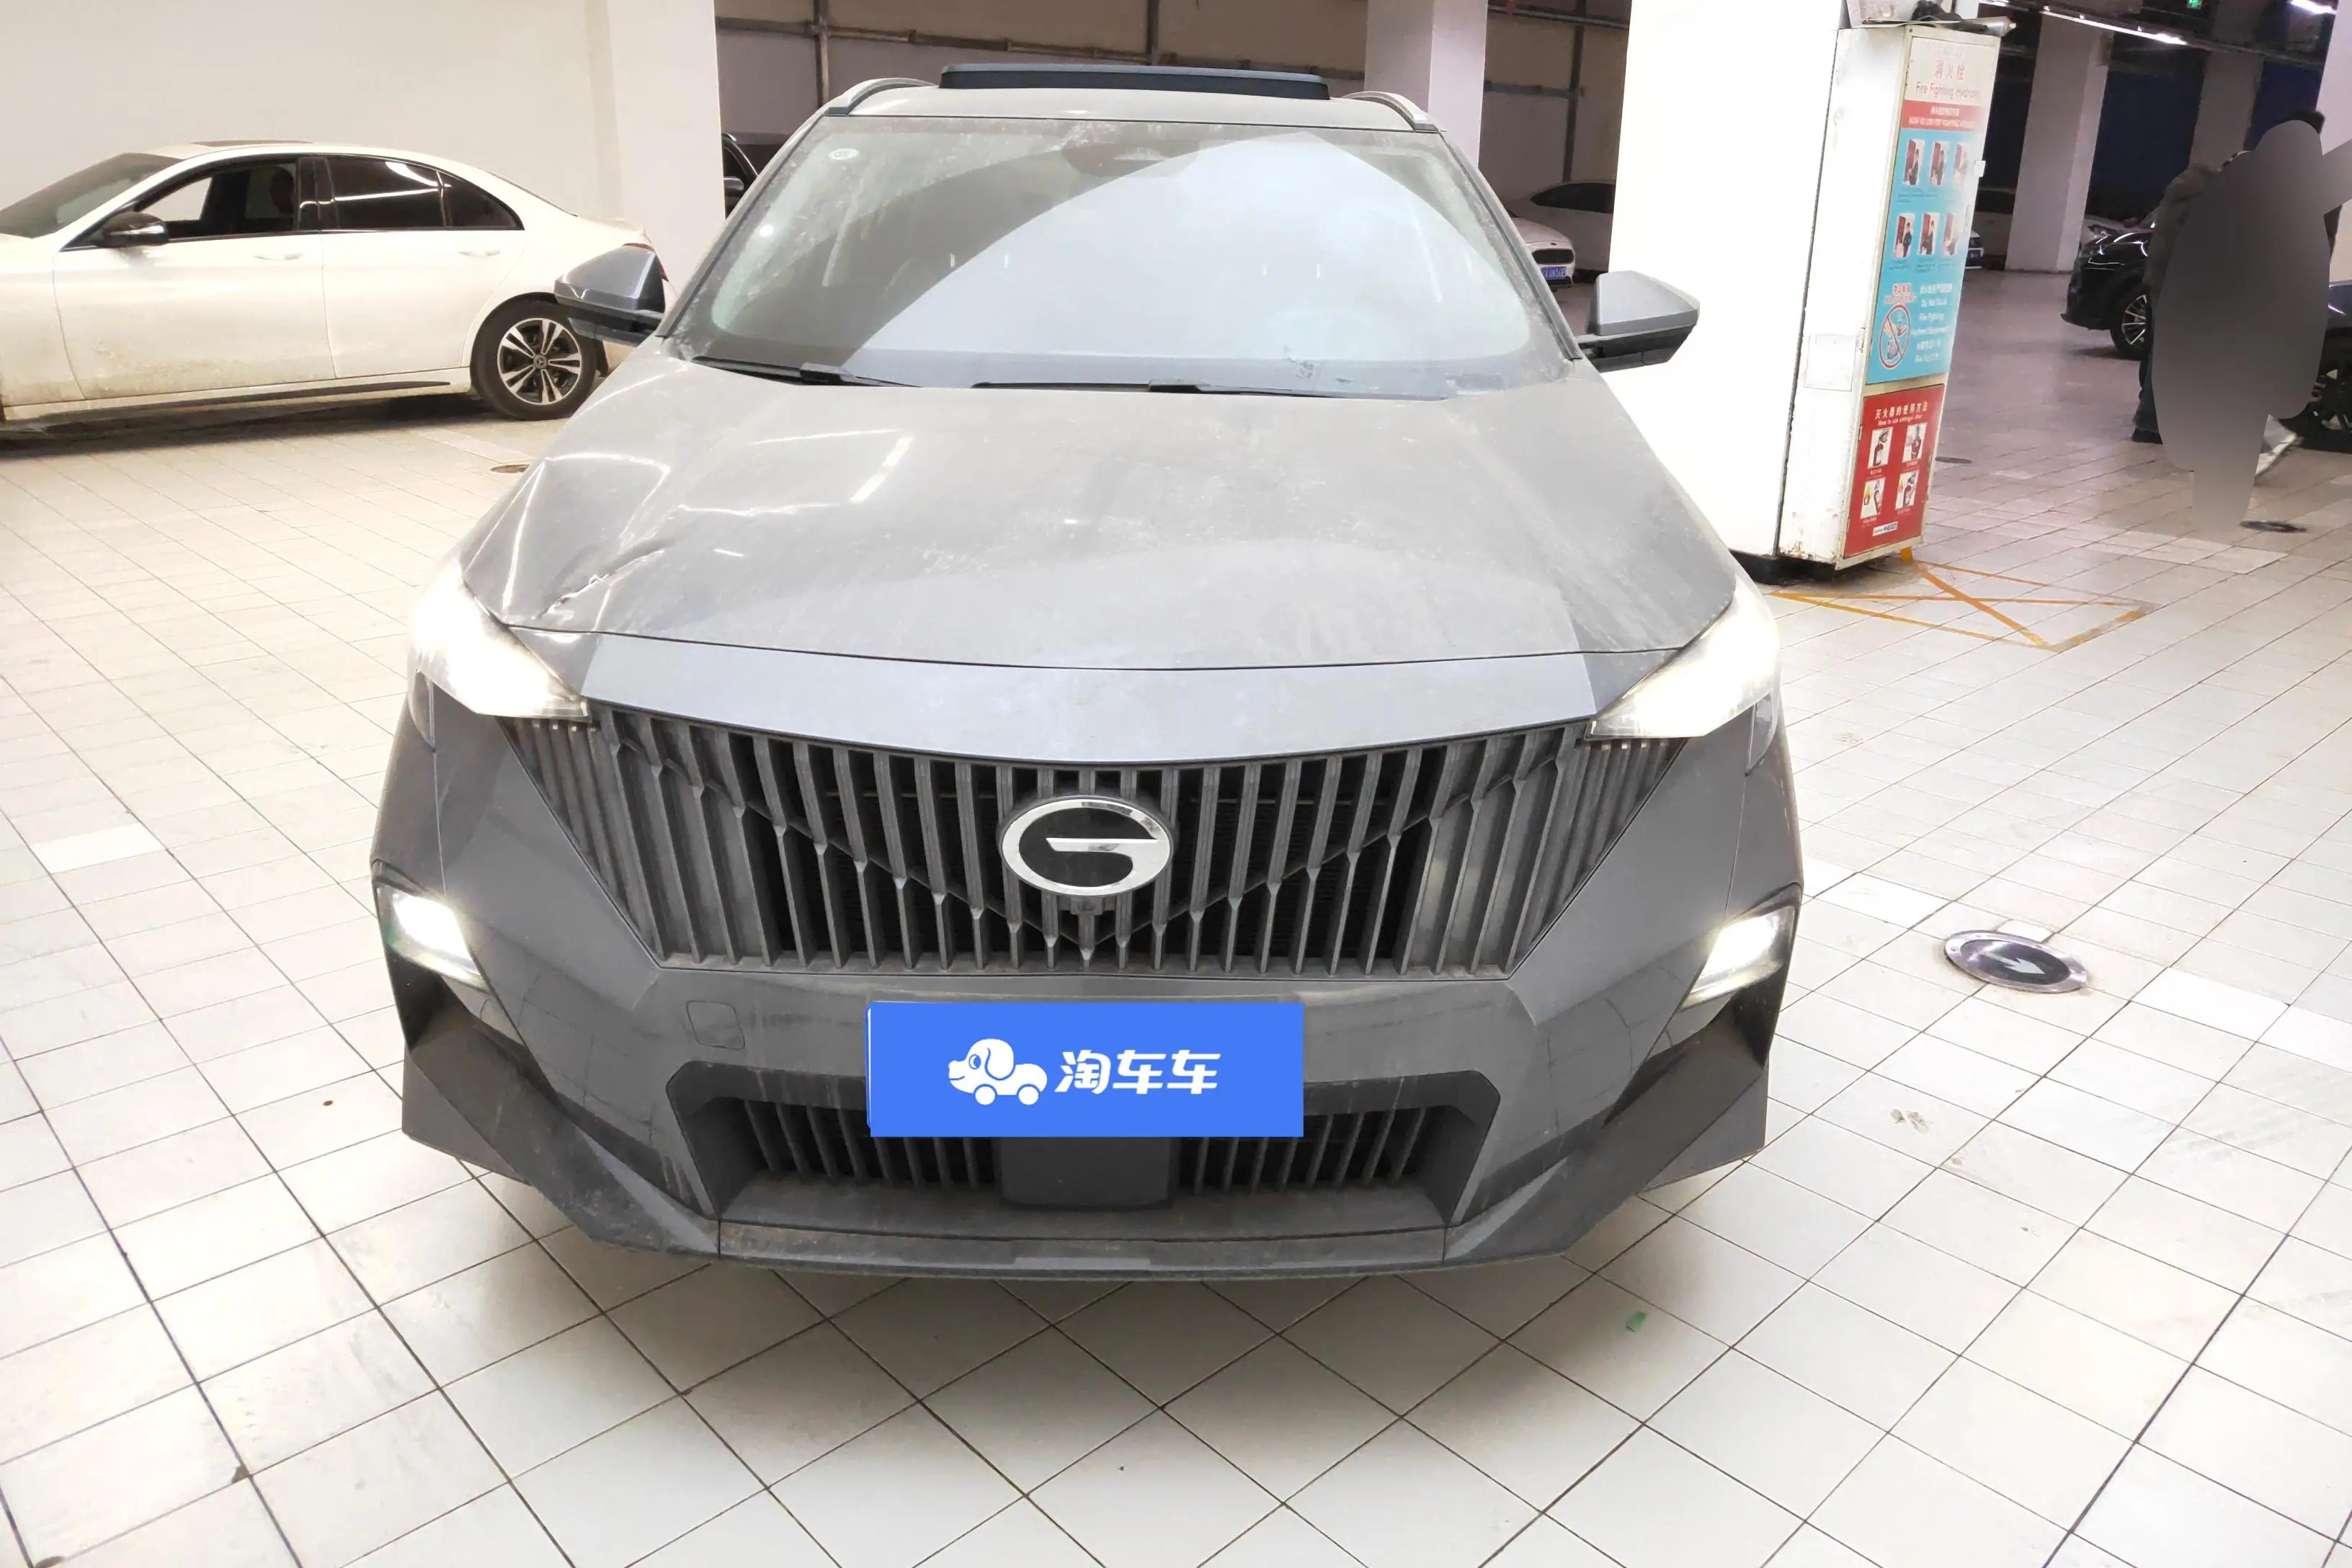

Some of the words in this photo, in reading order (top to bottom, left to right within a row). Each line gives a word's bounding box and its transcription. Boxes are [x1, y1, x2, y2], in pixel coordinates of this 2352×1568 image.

[1916, 81, 1928, 94] Fire
[1874, 401, 1928, 420] 灭火器的使用方法
